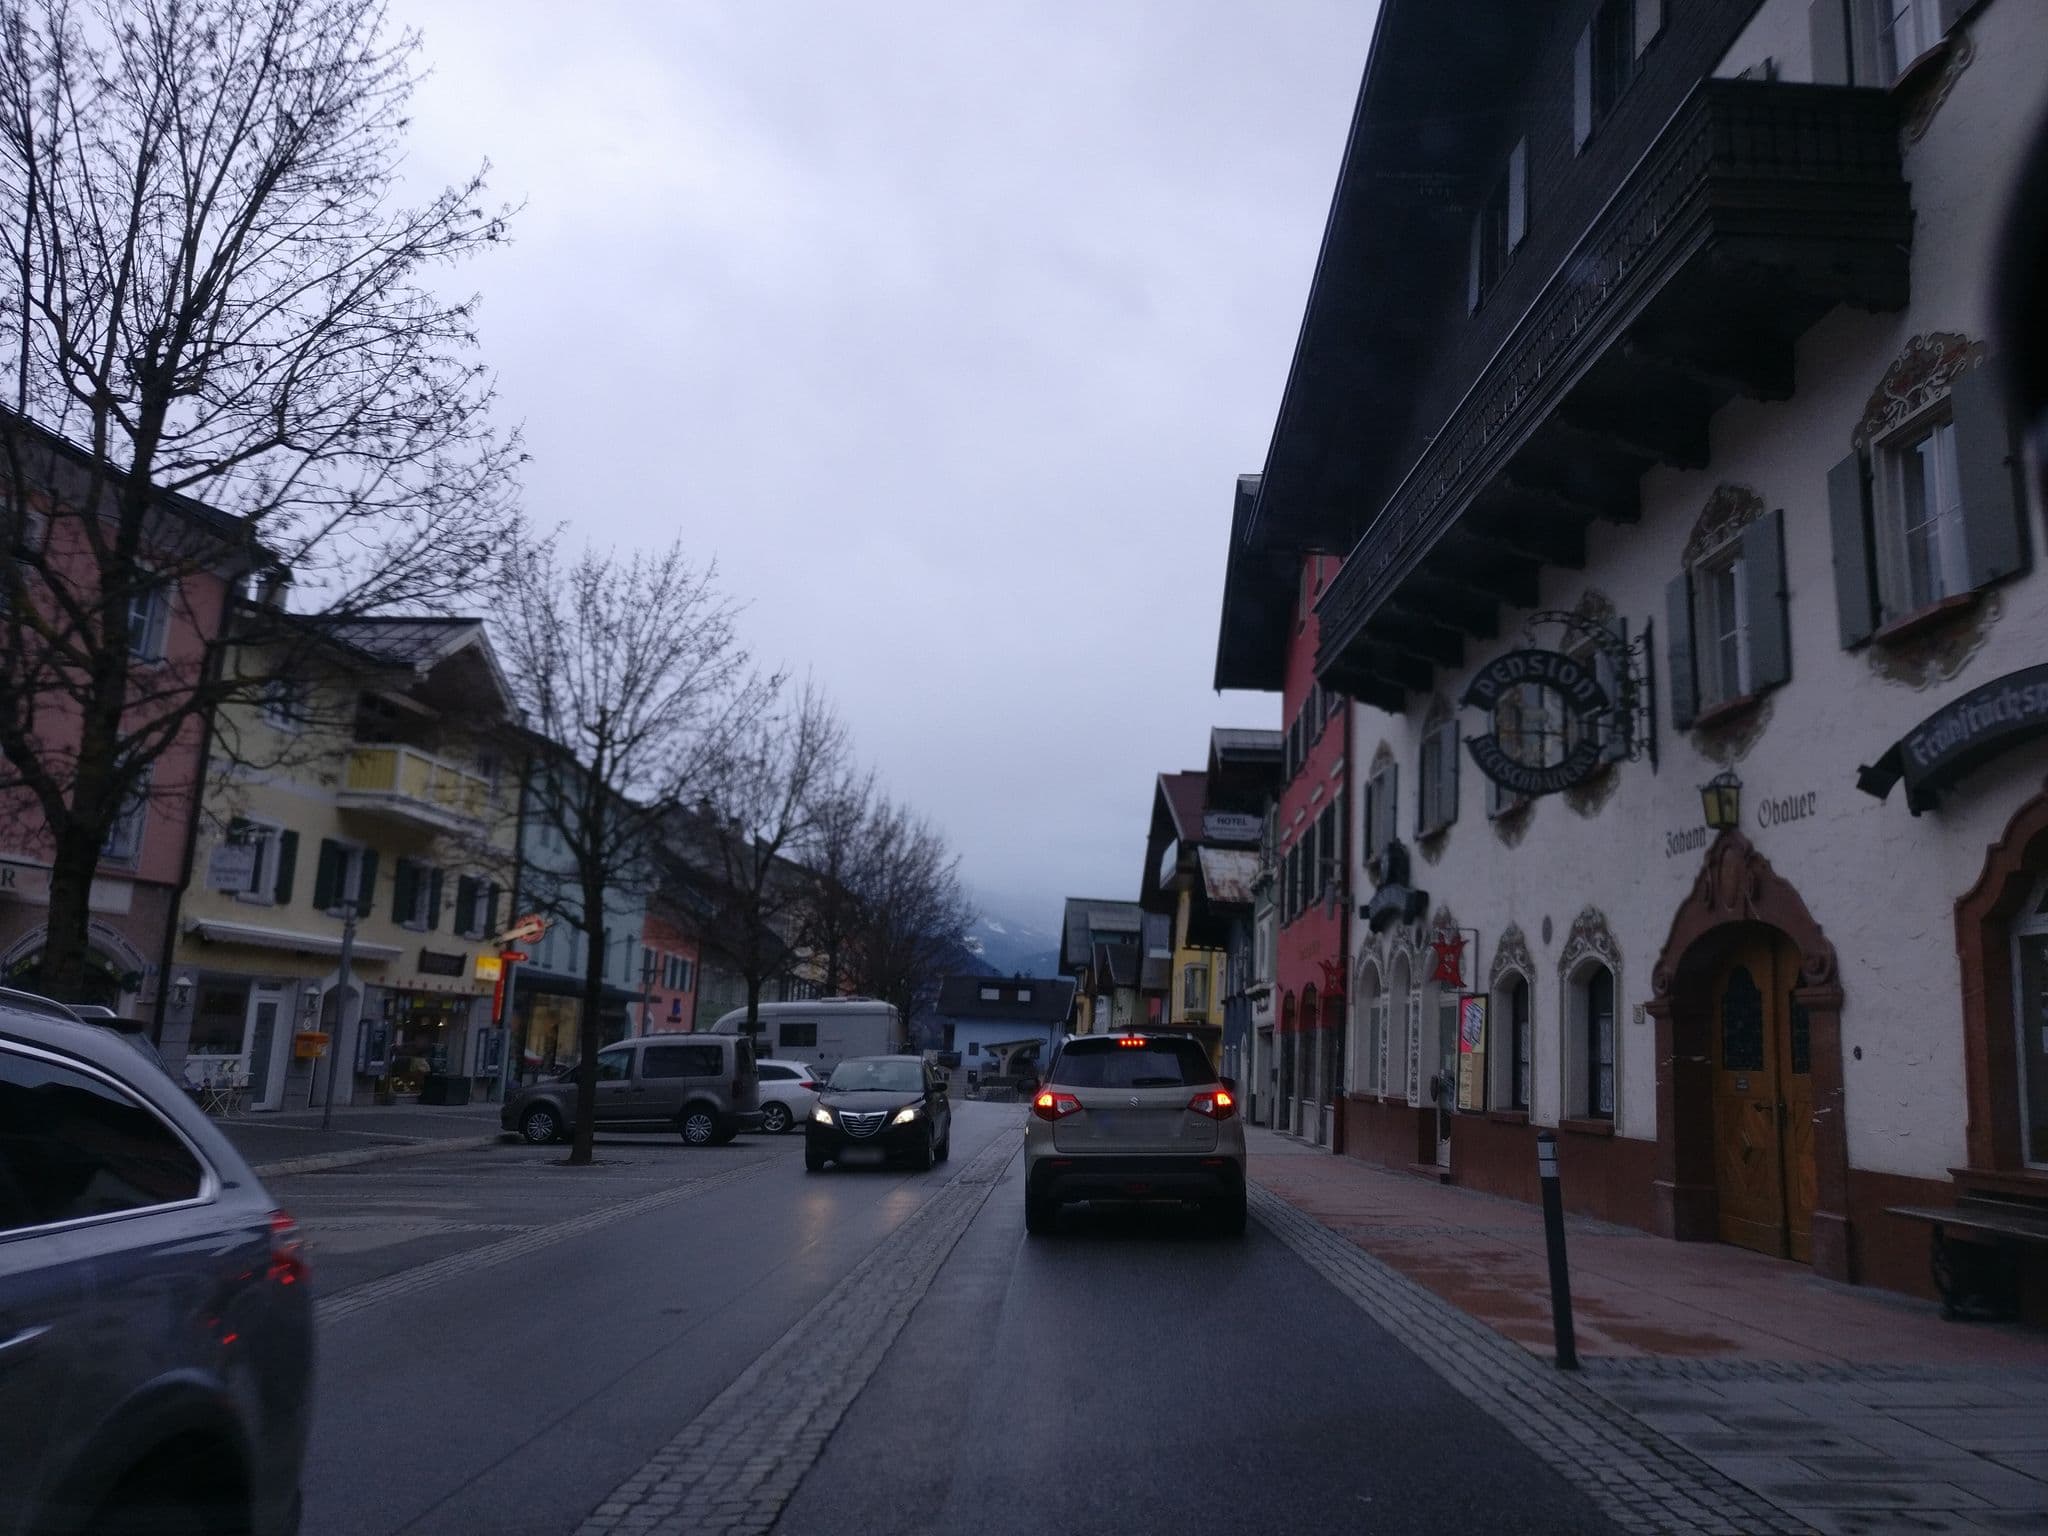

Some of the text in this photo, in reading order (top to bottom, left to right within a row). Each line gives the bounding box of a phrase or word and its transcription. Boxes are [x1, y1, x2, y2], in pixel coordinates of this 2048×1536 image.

[1474, 654, 1596, 702] PENSION
[1216, 816, 1248, 826] HOTEL
[1757, 790, 1816, 828] Obauer
